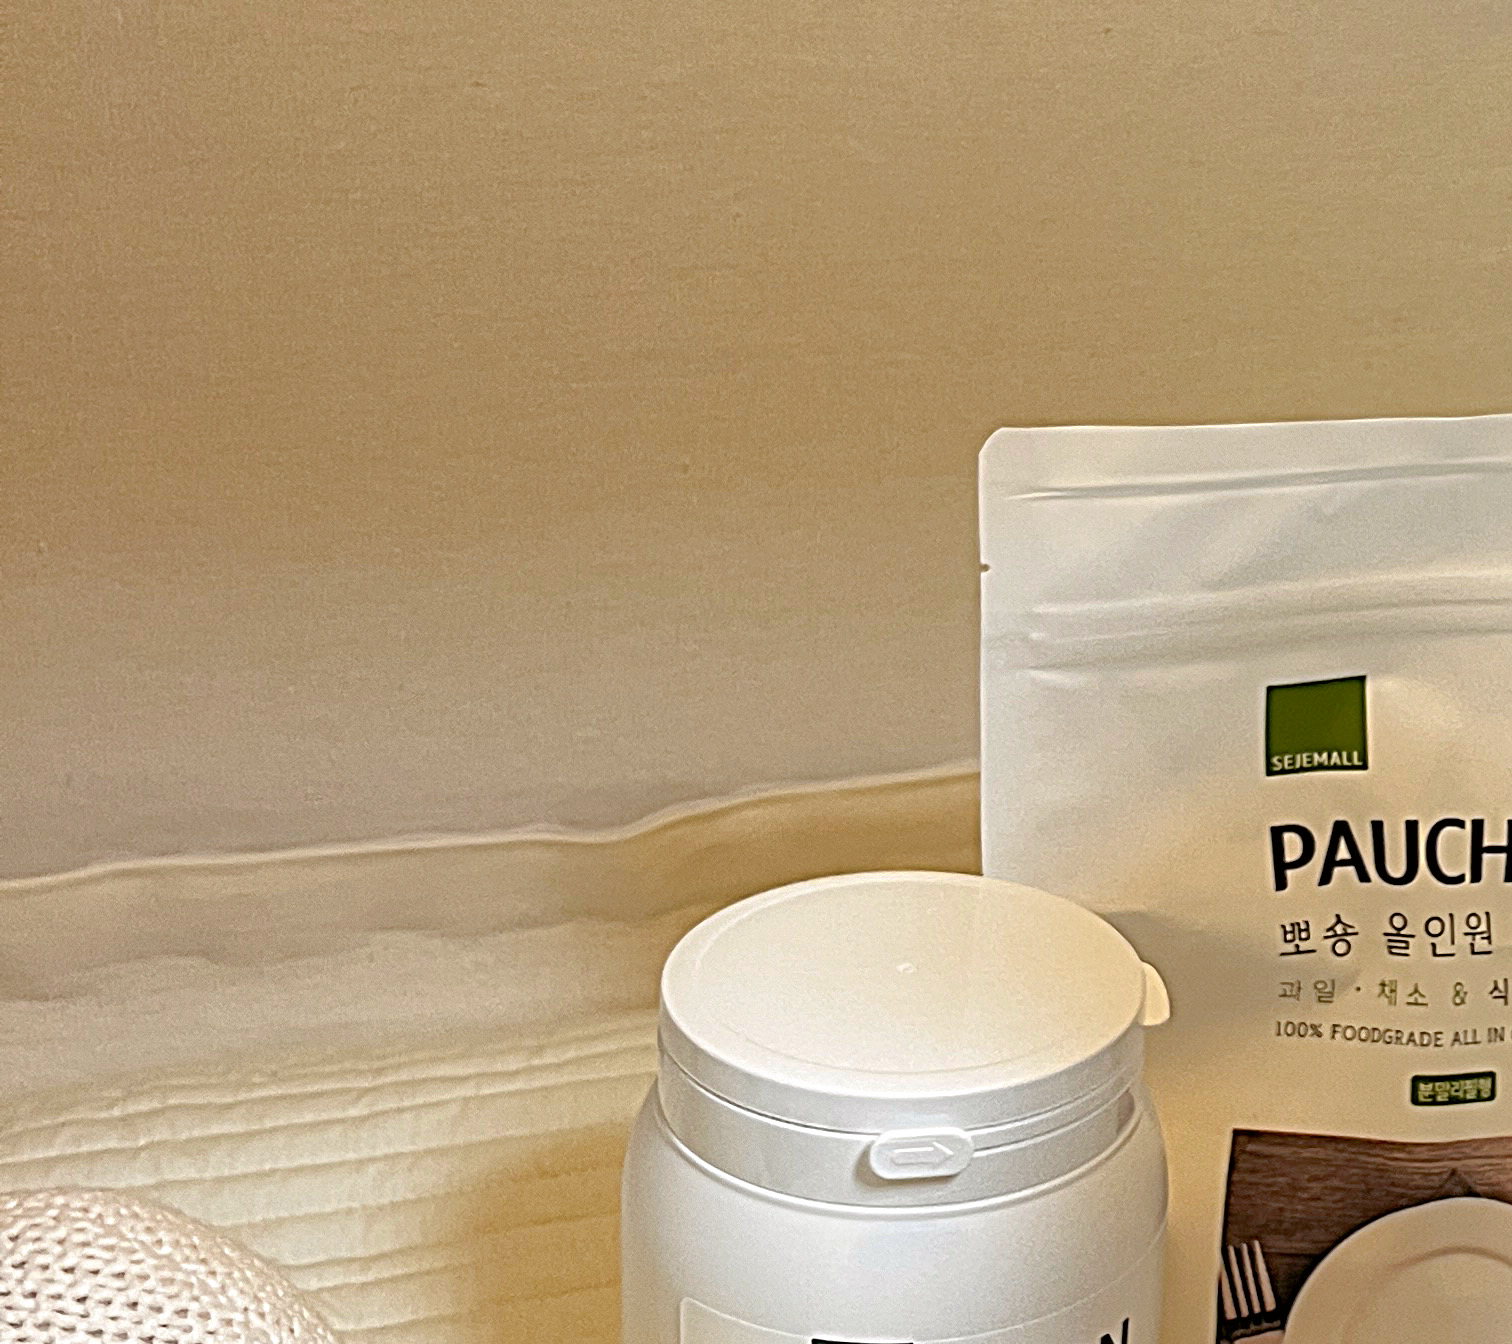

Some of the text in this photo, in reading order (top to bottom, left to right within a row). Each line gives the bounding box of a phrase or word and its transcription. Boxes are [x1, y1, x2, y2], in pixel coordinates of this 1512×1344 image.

[1271, 750, 1364, 772] SEJEMALL
[1279, 913, 1359, 958] 뽀숑
[1382, 911, 1494, 958] 올인원
[1452, 981, 1468, 1007] &
[1275, 1020, 1324, 1039] 100%
[1330, 1023, 1444, 1048] FOODGRADE
[1450, 1028, 1482, 1047] ALL
[1487, 1026, 1505, 1044] IN
